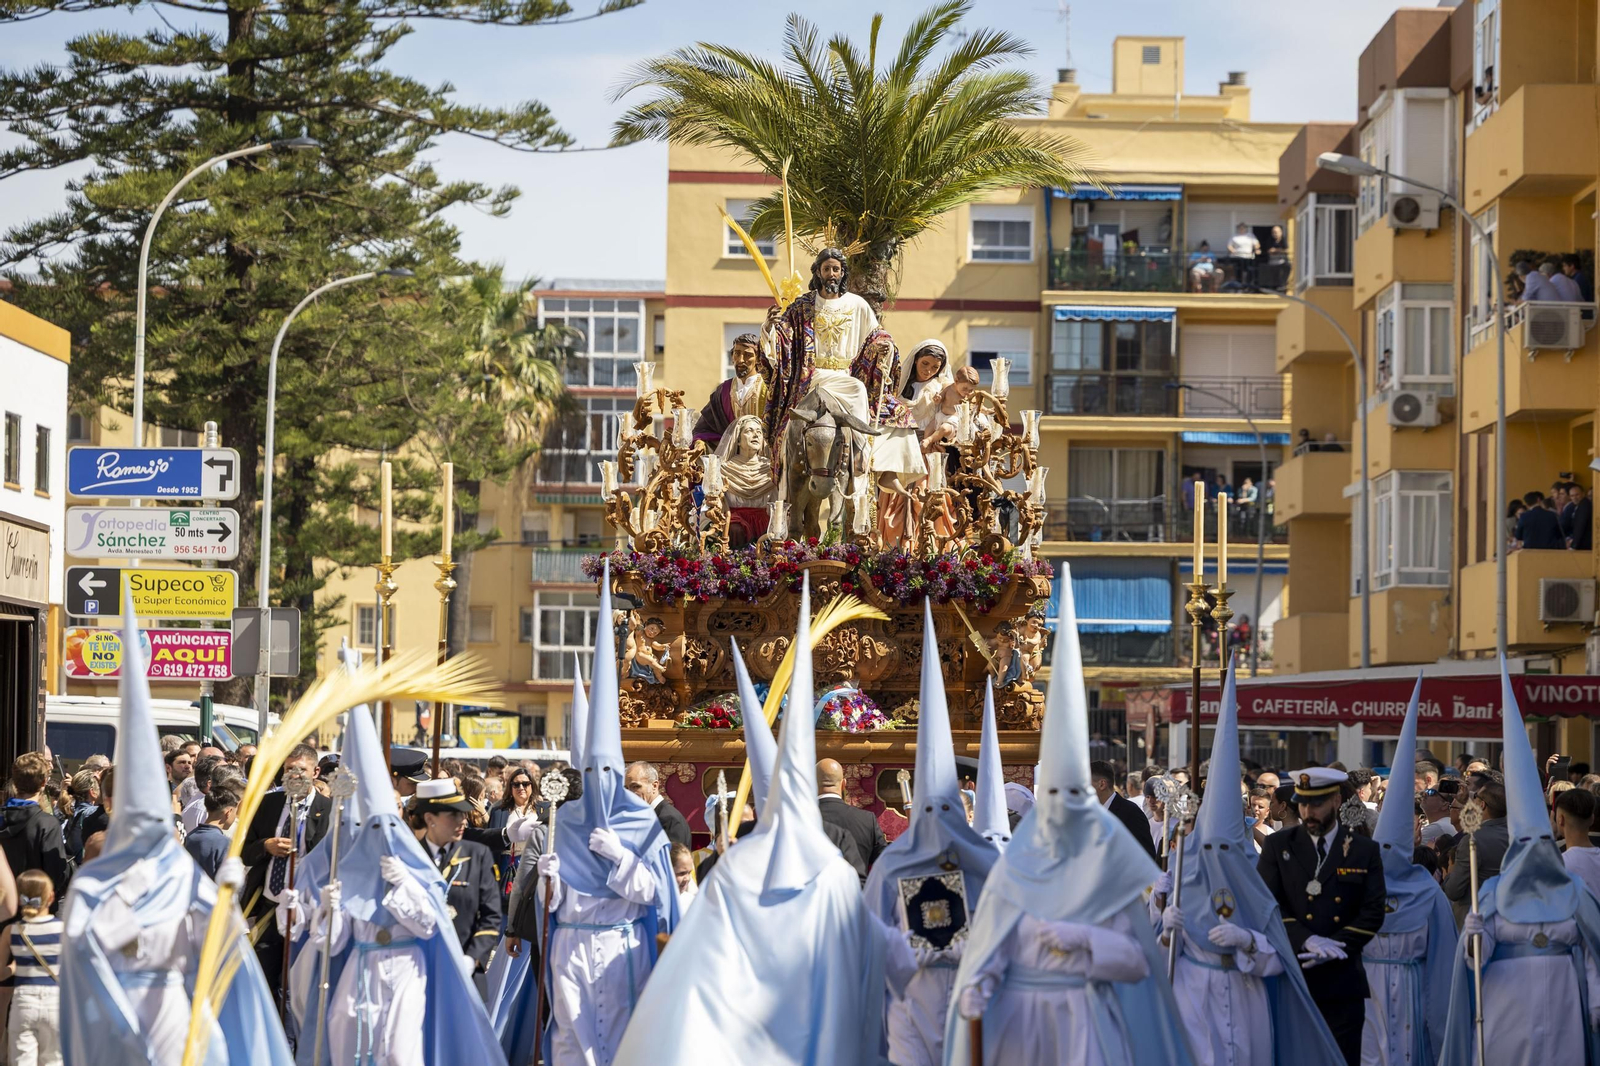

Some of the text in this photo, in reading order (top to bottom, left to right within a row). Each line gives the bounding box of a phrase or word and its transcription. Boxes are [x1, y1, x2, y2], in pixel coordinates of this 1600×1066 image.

[157, 486, 179, 494] Desde
[98, 517, 167, 532] ortopedia
[97, 529, 166, 547] Sánchez
[175, 527, 204, 538] 50 mts
[174, 545, 227, 554] 956 541 710
[130, 574, 205, 595] Supeco
[143, 595, 172, 606] Super
[175, 595, 227, 606] Económico
[87, 602, 96, 612] P
[152, 633, 229, 646] ANÚNCIATE
[89, 642, 120, 651] TE VEN
[92, 652, 114, 660] NO
[154, 646, 226, 664] AQUÍ
[89, 661, 117, 669] EXISTES
[163, 664, 228, 677] 619 472 758
[1525, 684, 1600, 703] VINOT
[1252, 697, 1339, 715] CAFETERÍA
[1352, 699, 1442, 717] CHURRRÍA
[1453, 701, 1494, 719] Dani
